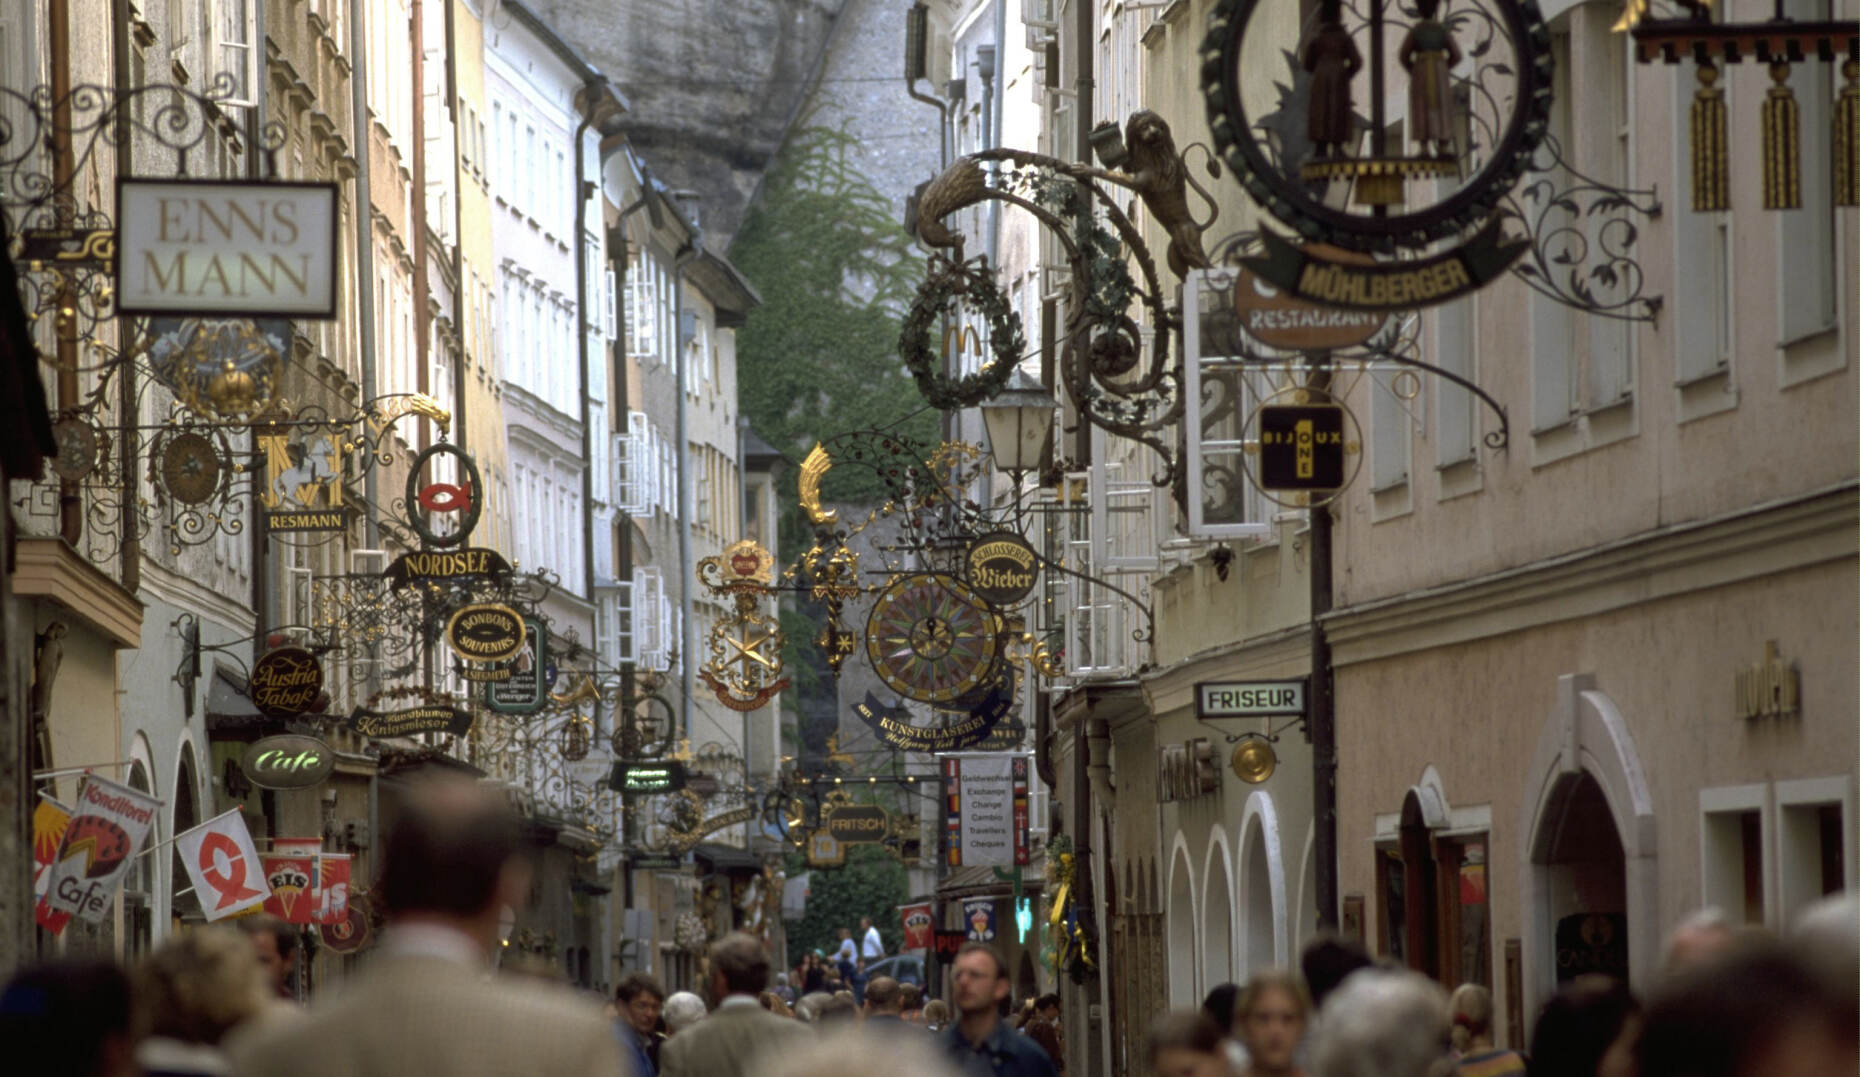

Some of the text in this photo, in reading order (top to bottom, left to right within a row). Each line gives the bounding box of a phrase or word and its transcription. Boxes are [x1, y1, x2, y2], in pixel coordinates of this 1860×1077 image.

[158, 198, 299, 245] ENNS
[142, 250, 312, 297] MANN
[1299, 258, 1471, 305] MÜHLBERGER
[1251, 309, 1378, 329] RESTAURANT
[1263, 431, 1341, 444] BIJOUX
[269, 514, 342, 529] RESMANN
[973, 543, 1031, 562] SCHLOSSEREI
[404, 552, 491, 577] NORDSEE
[970, 565, 1032, 589] Wieber
[461, 613, 513, 631] BONBONS
[459, 635, 515, 653] SOUVENIRS
[252, 659, 318, 686] Austria
[255, 684, 314, 707] Tabak
[1208, 689, 1296, 709] FRISEUR
[880, 716, 986, 739] KUNSTGLASEREI
[254, 749, 320, 773] Café
[967, 787, 1006, 795] Exchange
[84, 783, 154, 825] Konditorei
[971, 800, 1002, 809] Change
[831, 817, 885, 831] FRITSCH
[971, 813, 1003, 821] Cambio
[970, 839, 1005, 848] Cheques
[268, 872, 308, 890] EIS
[57, 875, 105, 915] Café
